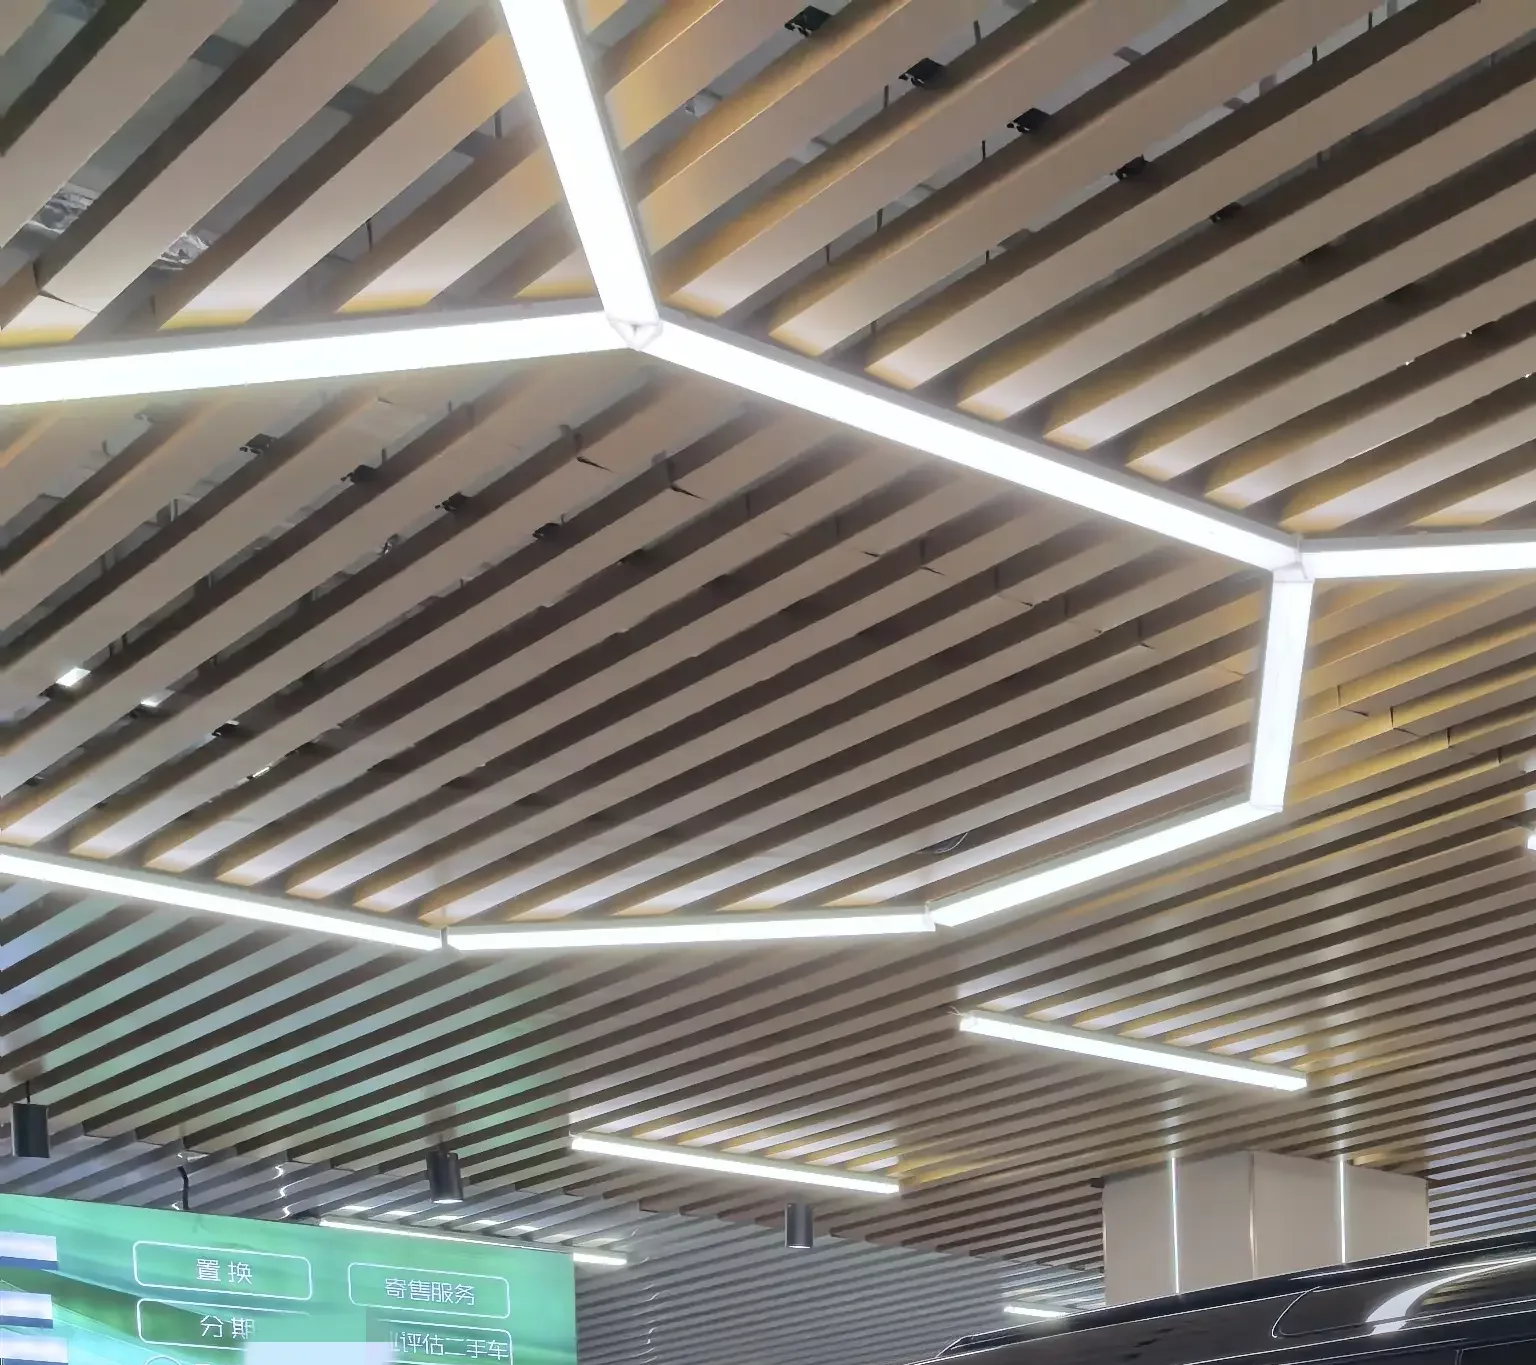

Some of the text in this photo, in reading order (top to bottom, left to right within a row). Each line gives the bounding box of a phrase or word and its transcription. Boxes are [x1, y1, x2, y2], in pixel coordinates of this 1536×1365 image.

[196, 1258, 253, 1285] 置换
[384, 1278, 475, 1306] 寄售服务
[200, 1315, 255, 1340] 分期
